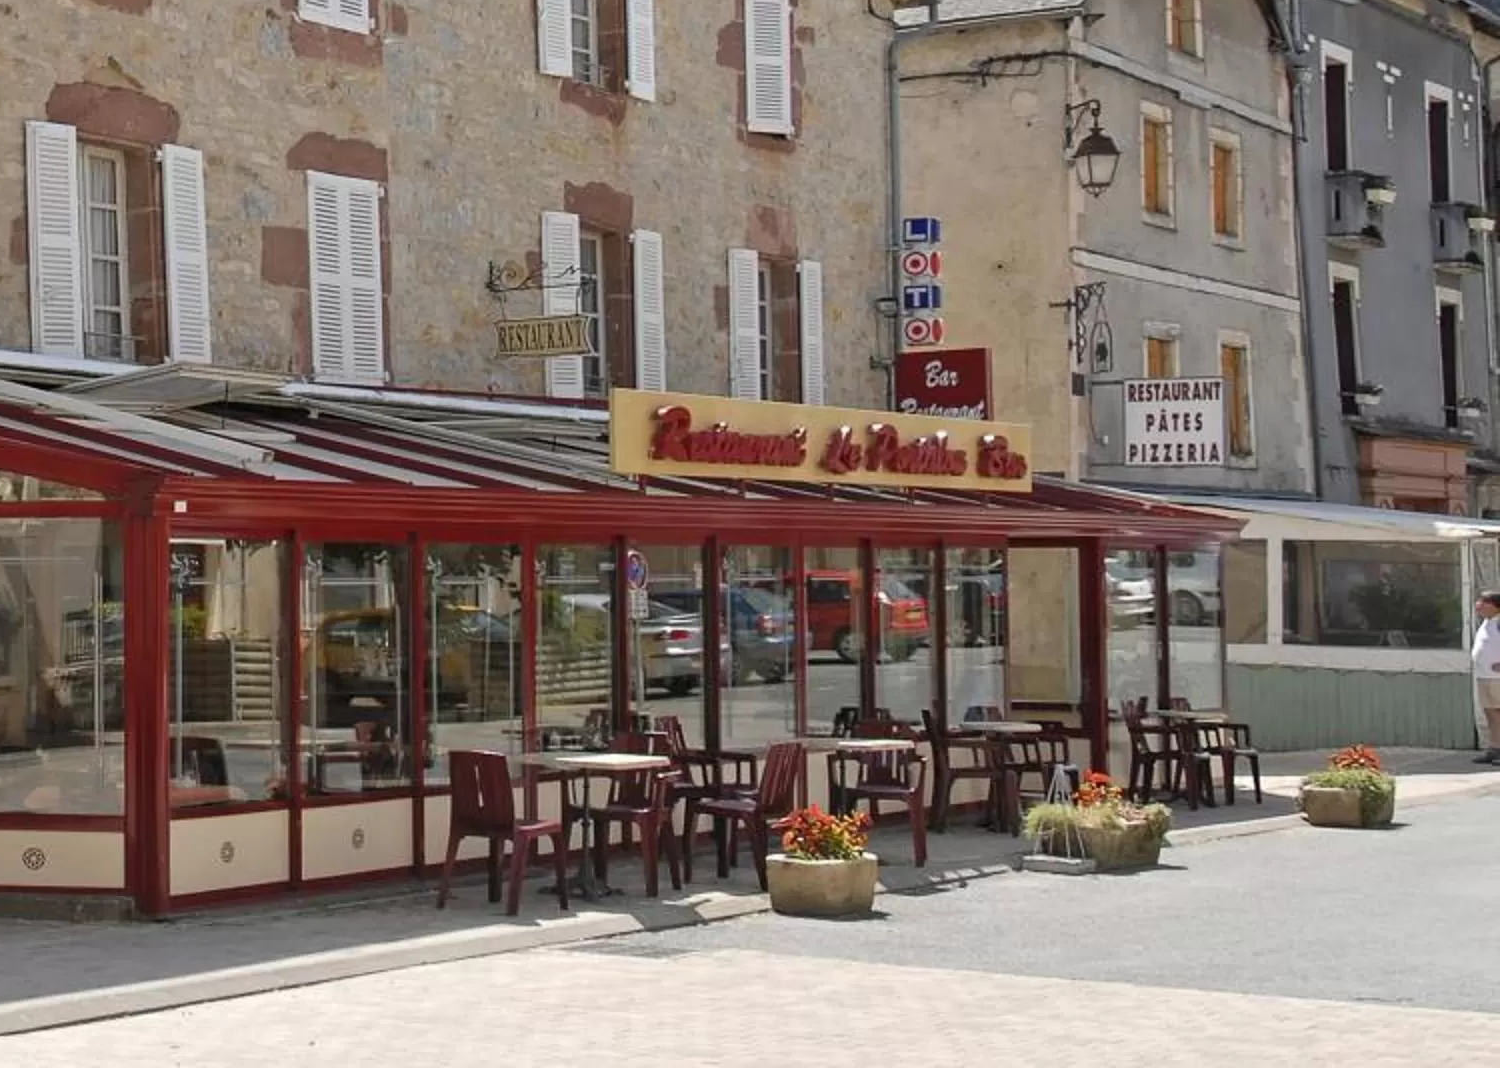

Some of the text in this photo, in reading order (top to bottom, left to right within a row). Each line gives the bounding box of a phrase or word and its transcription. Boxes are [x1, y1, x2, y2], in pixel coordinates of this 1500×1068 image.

[499, 319, 583, 353] RESTAURANT
[924, 360, 959, 388] Bar
[1127, 381, 1221, 402] RESTAURANT
[1145, 408, 1204, 432] PÂTES
[648, 406, 806, 467] Restaurant
[1129, 443, 1221, 463] PIZZERIA
